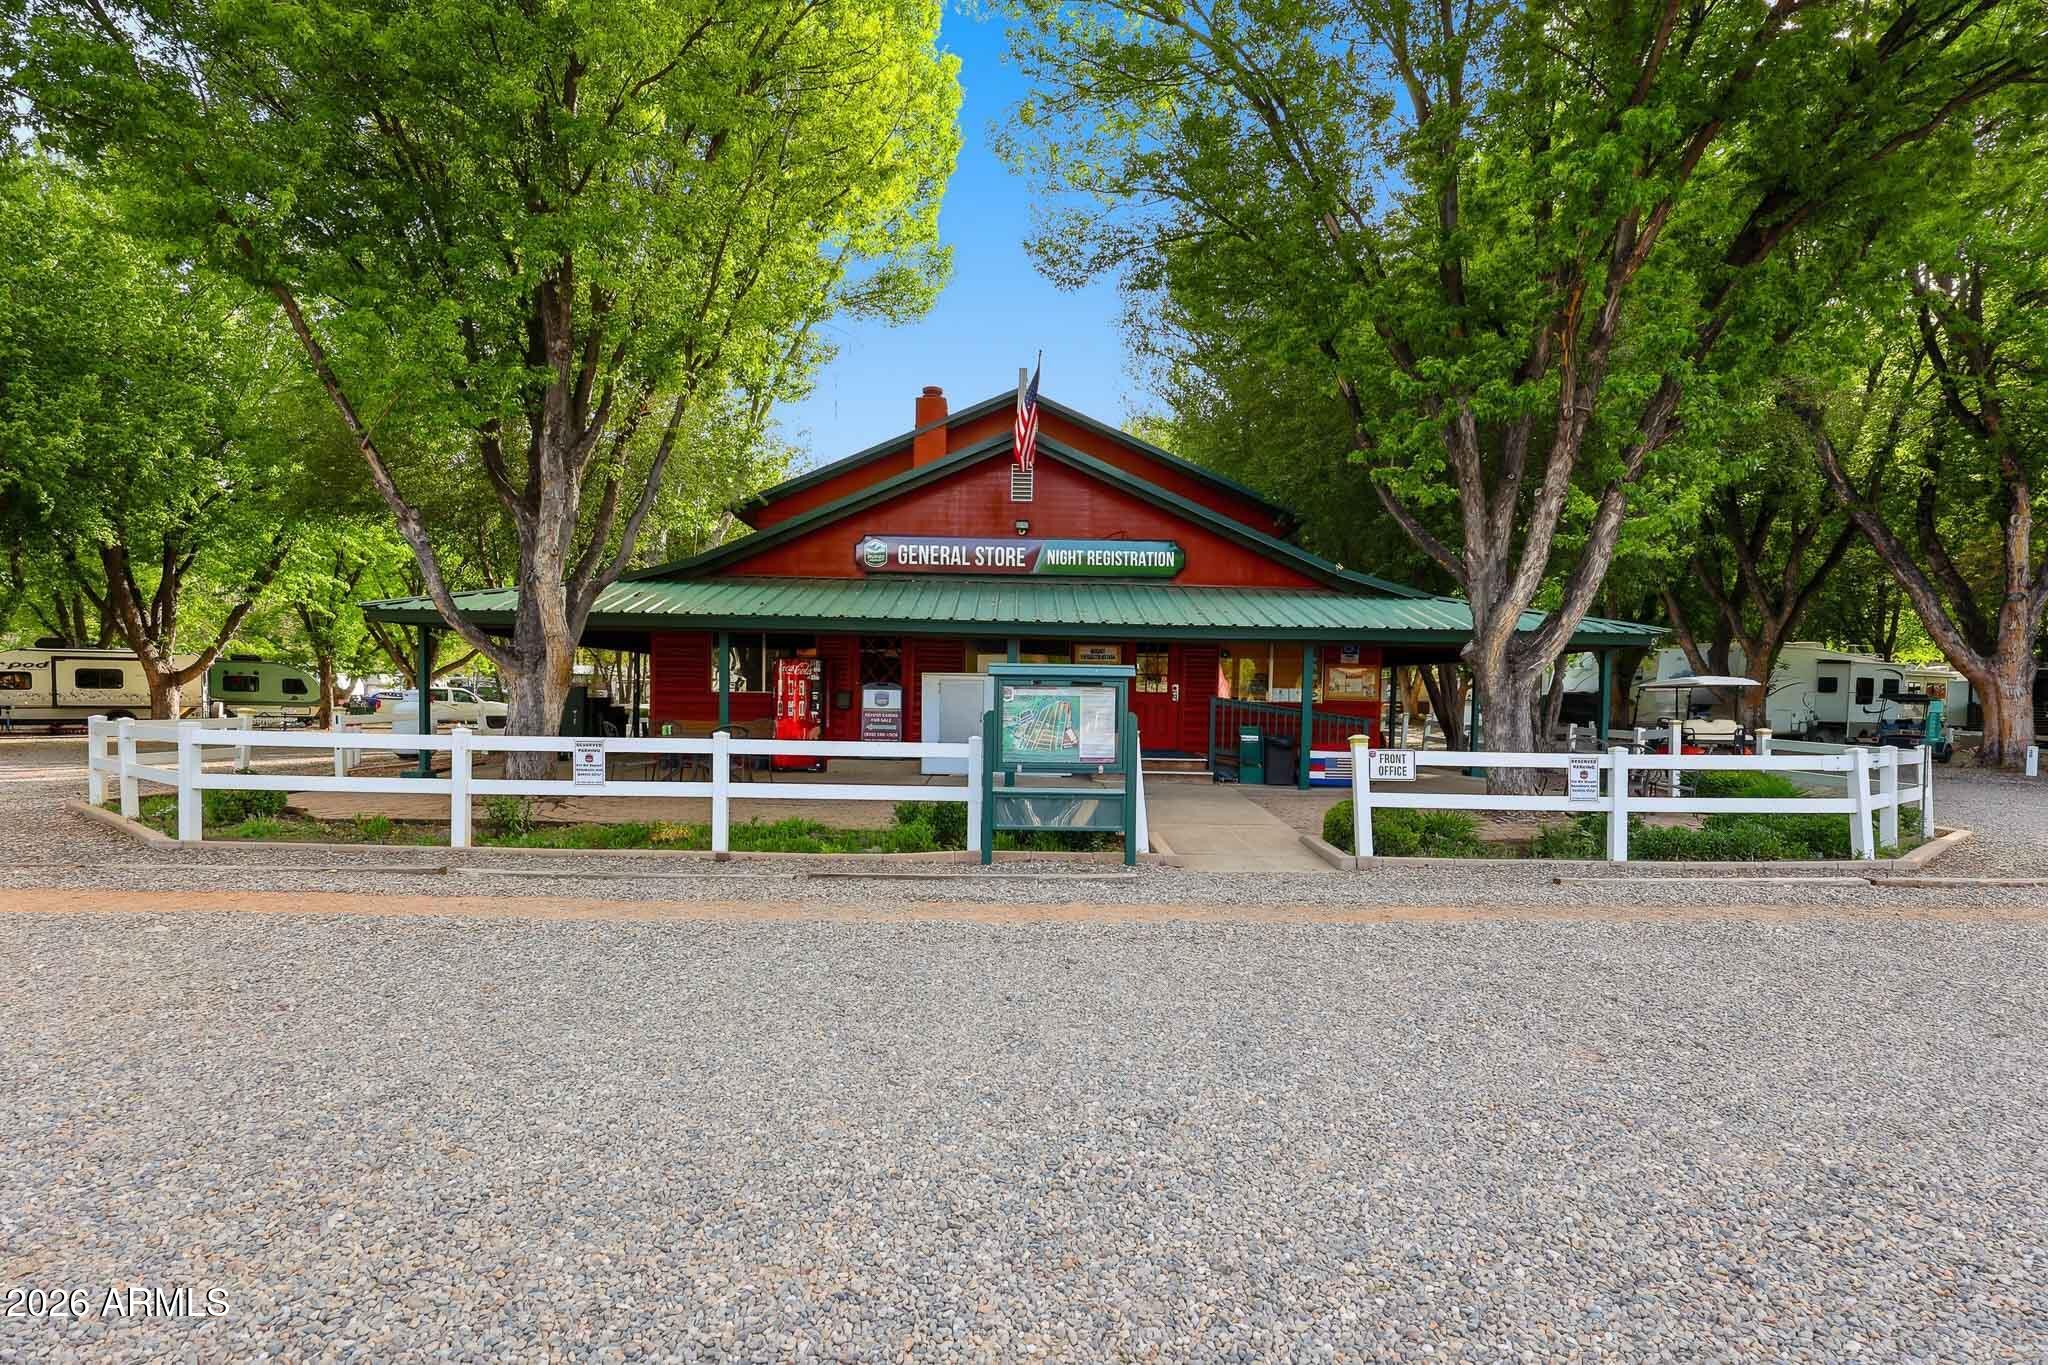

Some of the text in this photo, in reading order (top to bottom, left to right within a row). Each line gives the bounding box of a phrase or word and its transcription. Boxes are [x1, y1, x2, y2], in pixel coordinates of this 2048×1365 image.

[897, 544, 971, 566] GENERAL
[974, 546, 1026, 567] STORE
[1047, 549, 1175, 567] NIGHT REGISTRATION
[1379, 753, 1407, 765] FRONT
[1378, 765, 1408, 777] OFFICE
